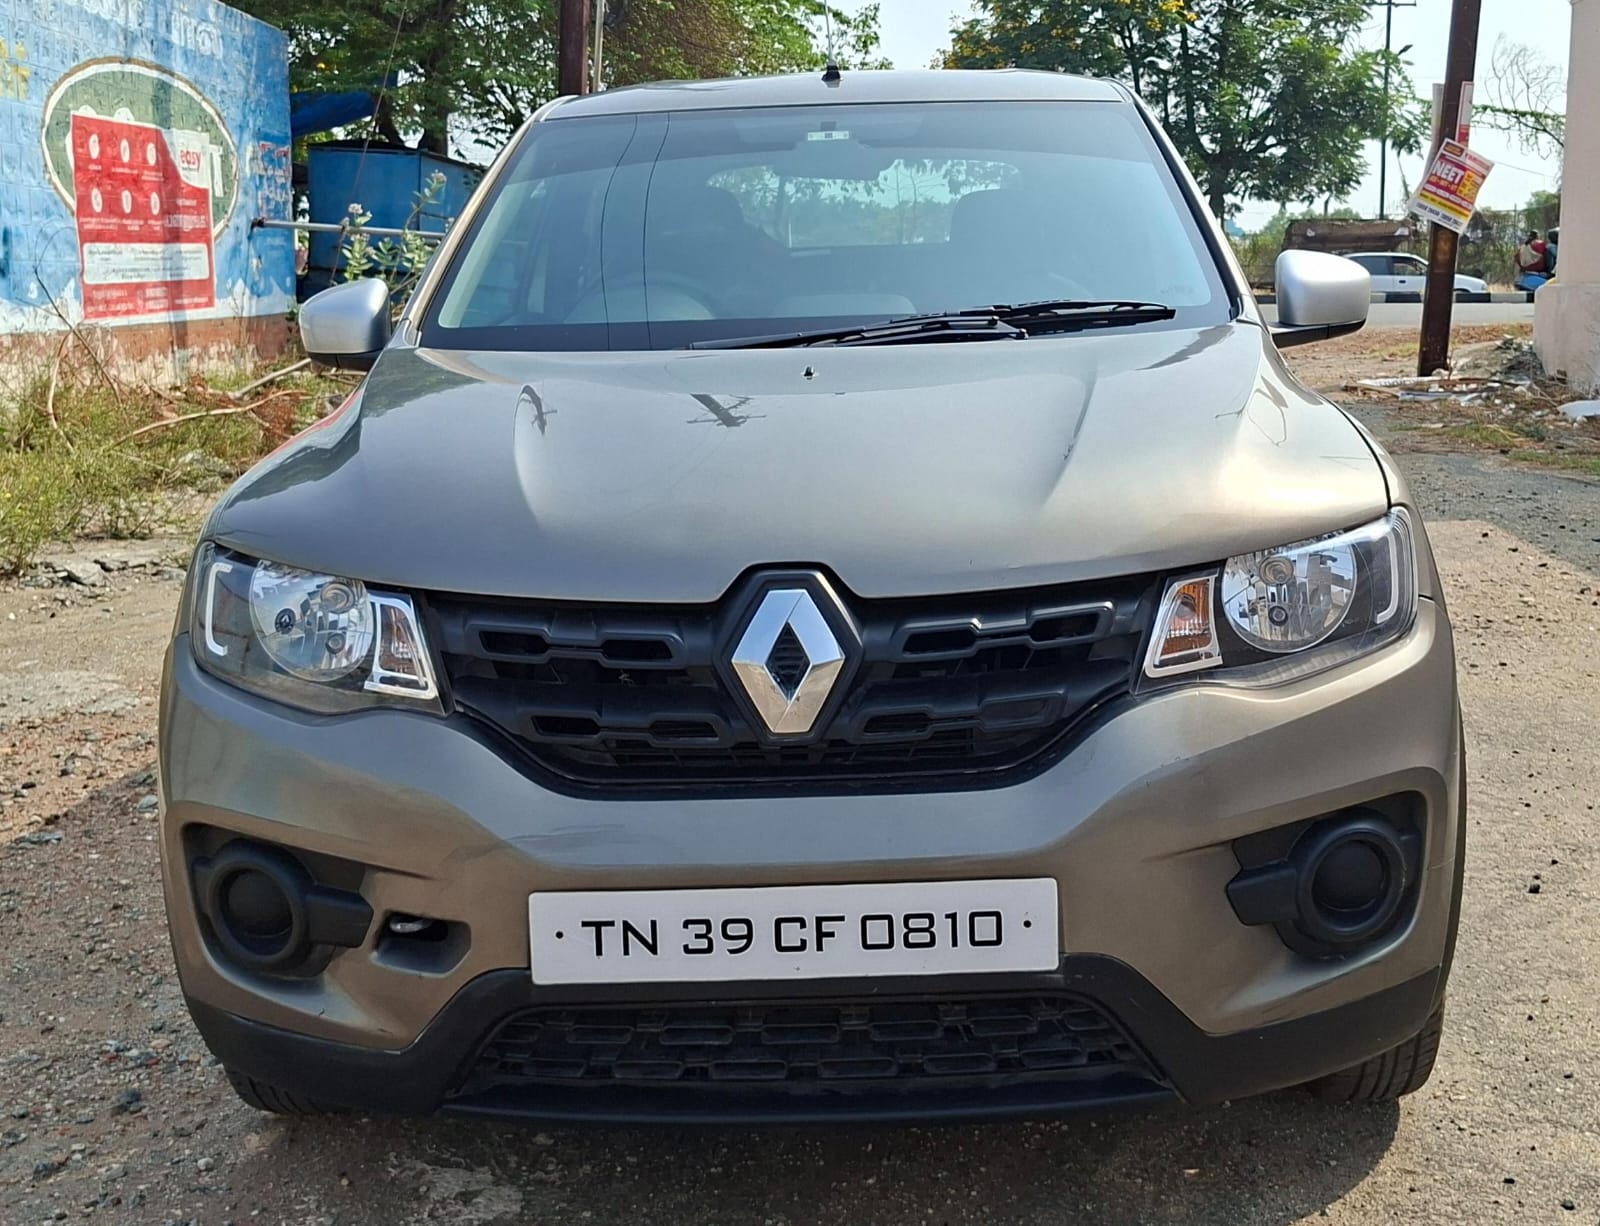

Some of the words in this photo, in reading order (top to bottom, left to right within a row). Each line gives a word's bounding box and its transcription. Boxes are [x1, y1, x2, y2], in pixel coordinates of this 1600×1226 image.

[179, 149, 201, 173] easy
[1431, 160, 1465, 184] NEET
[581, 918, 658, 957] TN
[682, 917, 754, 955] 39
[774, 915, 846, 953] CF
[860, 910, 1003, 951] 0810
